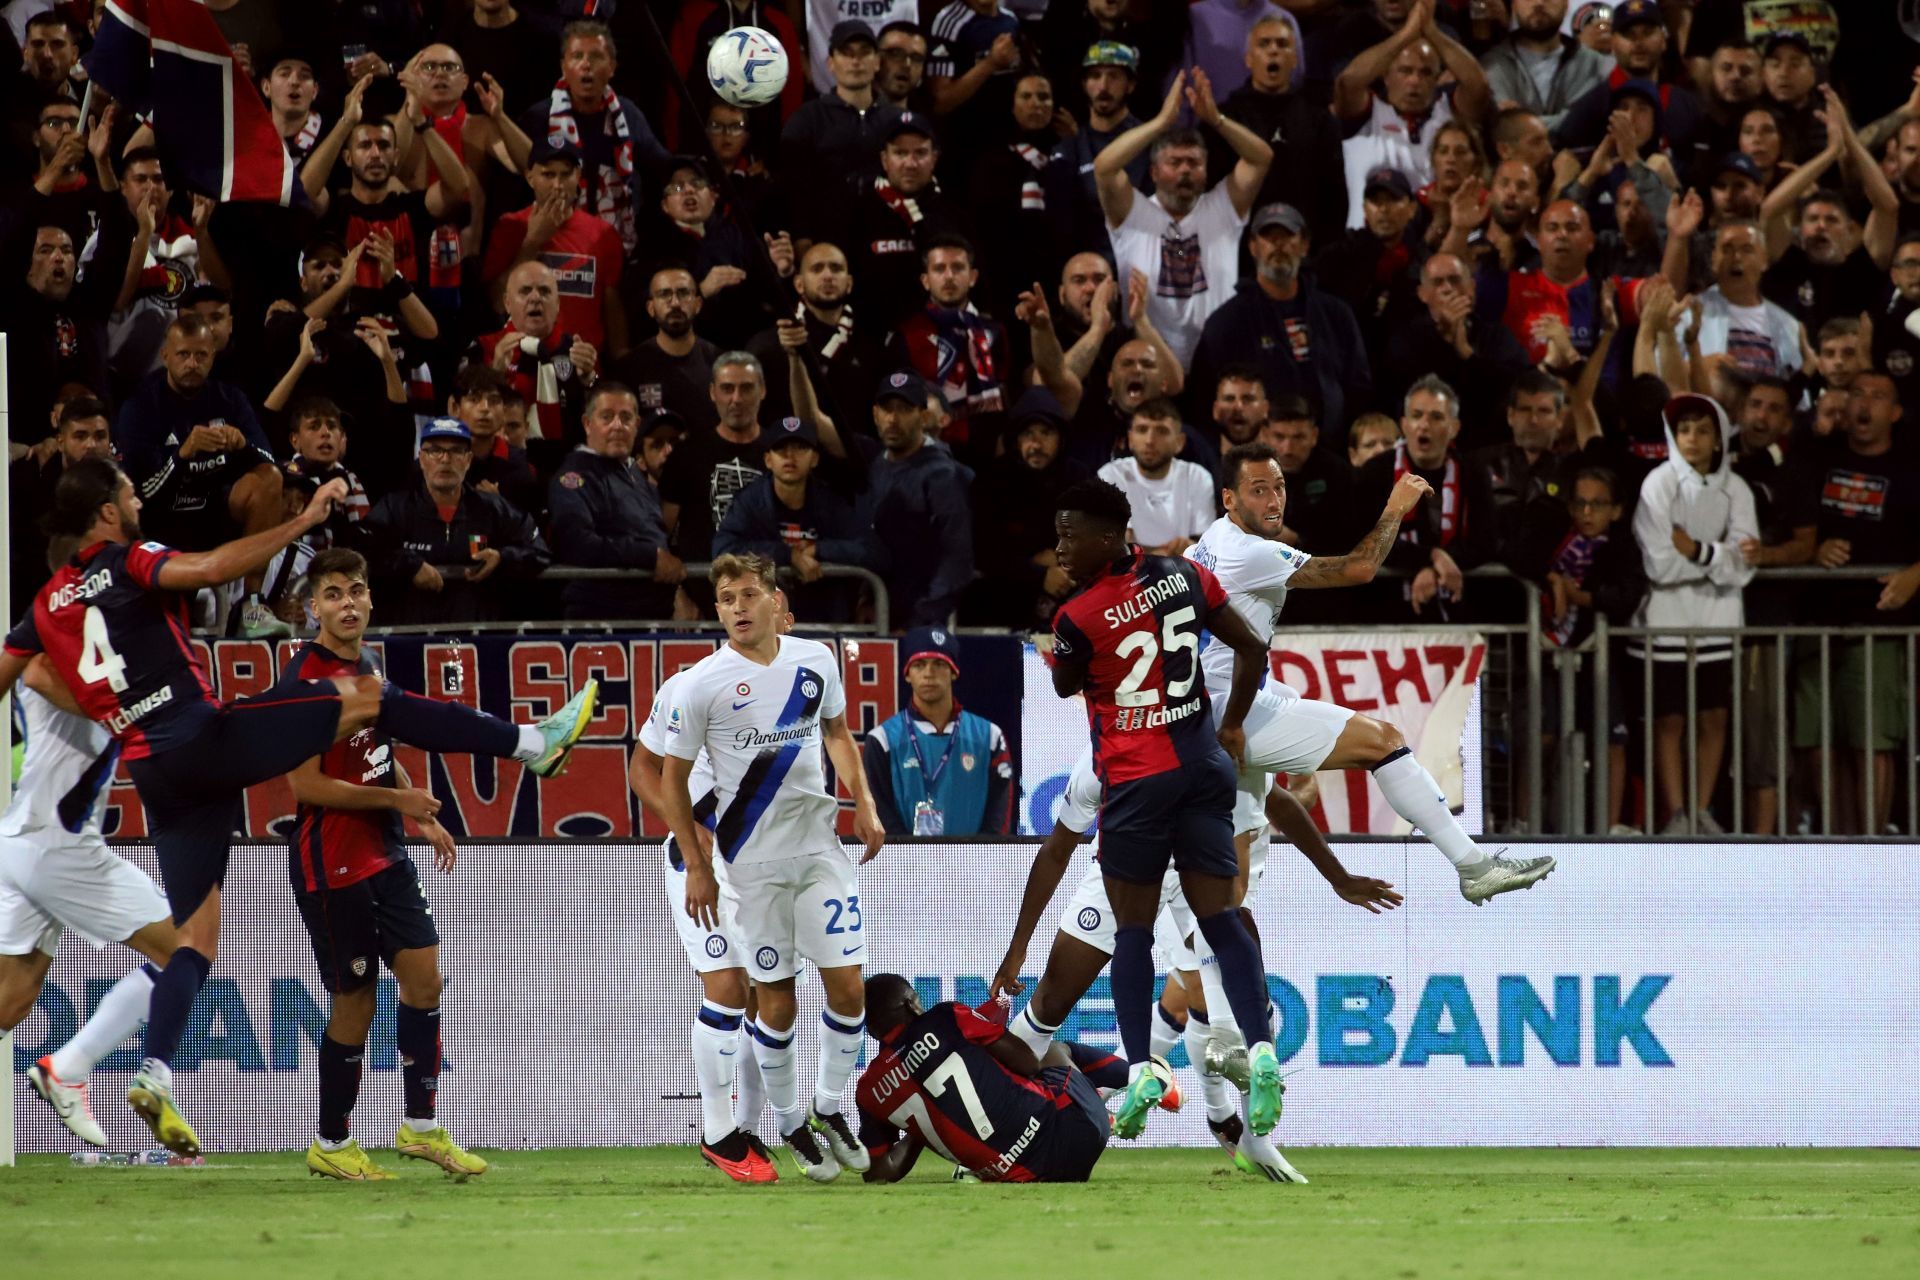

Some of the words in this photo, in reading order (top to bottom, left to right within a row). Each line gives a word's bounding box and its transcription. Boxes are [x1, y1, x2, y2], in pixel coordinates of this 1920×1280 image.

[48, 568, 113, 613] DOSSENA
[1103, 572, 1190, 629] SULEMANA
[77, 605, 129, 694] 4
[1114, 604, 1199, 707] 25
[1144, 697, 1202, 729] Ichnua
[361, 760, 392, 783] MOBY
[823, 896, 861, 935] 23
[1201, 955, 1220, 966] INTE
[871, 1031, 940, 1105] LUVUMBO
[887, 1050, 994, 1166] 77
